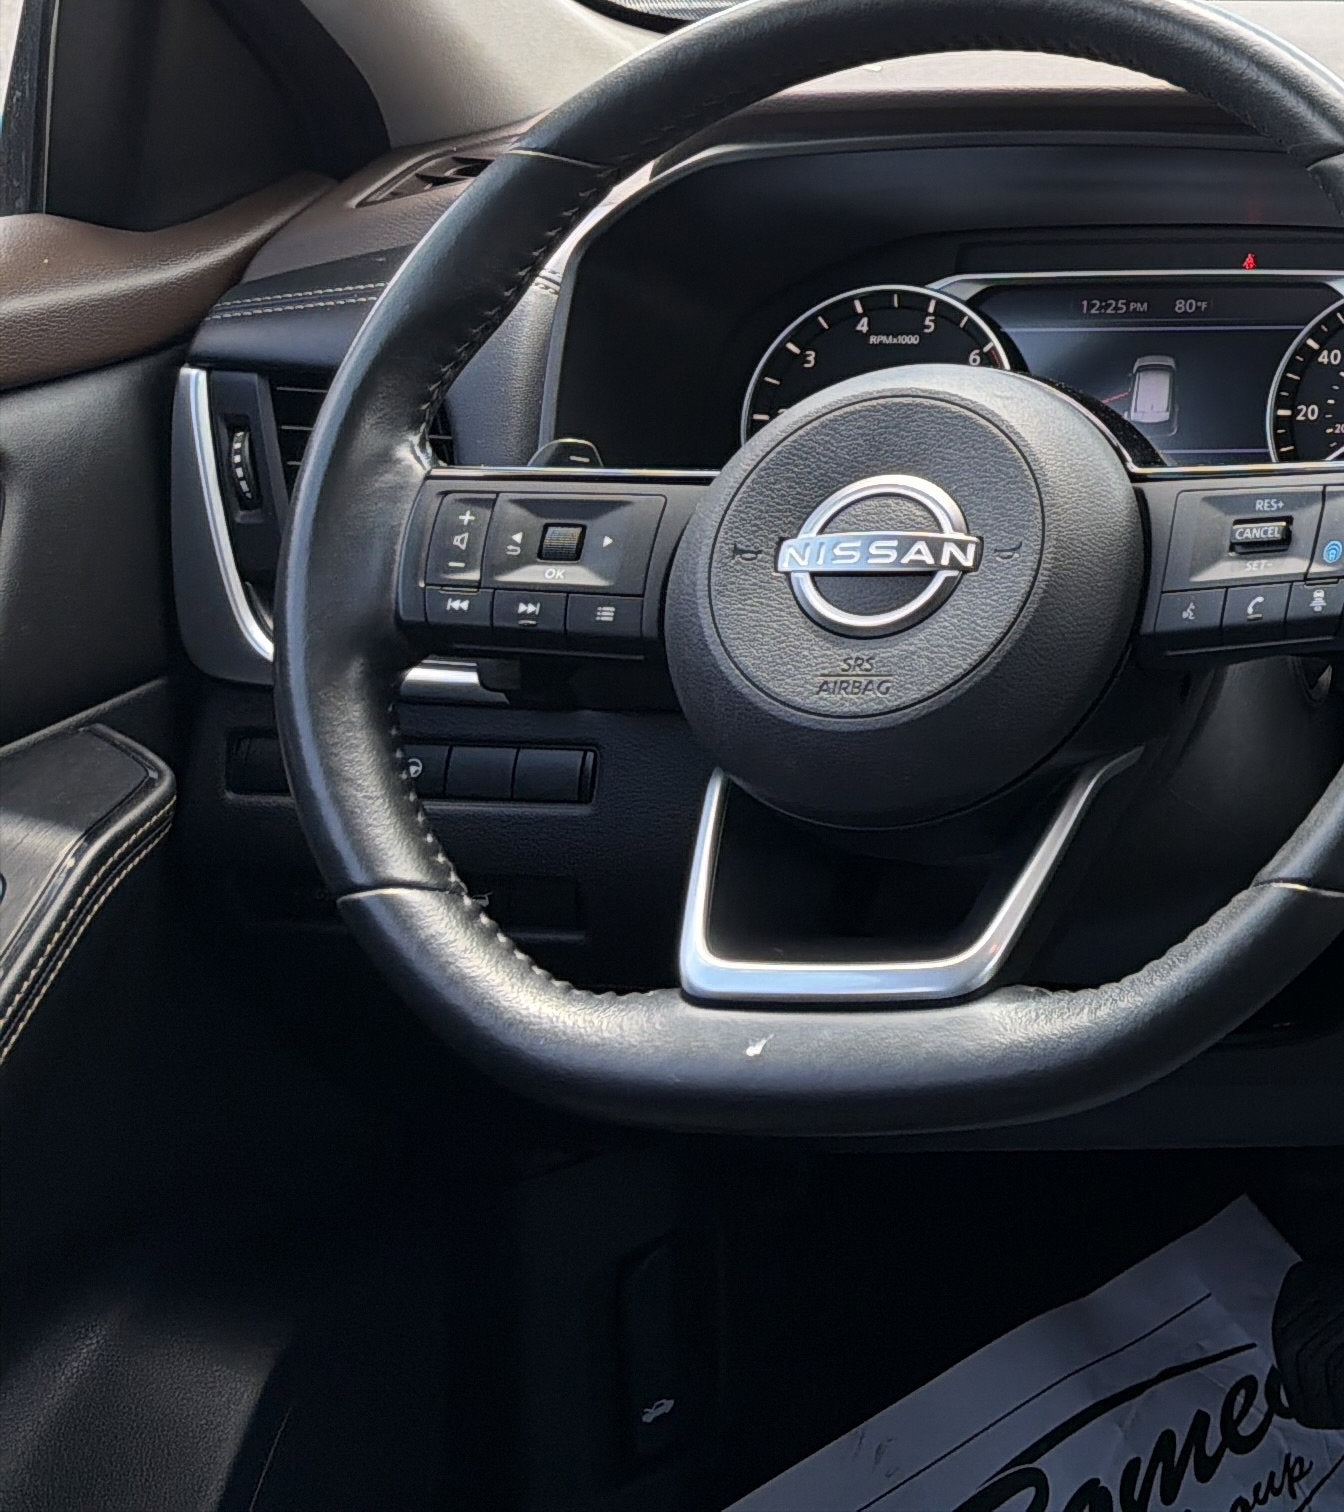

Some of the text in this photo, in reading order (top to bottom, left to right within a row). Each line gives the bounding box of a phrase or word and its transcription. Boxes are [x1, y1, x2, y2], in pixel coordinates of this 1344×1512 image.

[1081, 299, 1148, 314] 12:25 PM
[1174, 298, 1208, 314] 80°F
[855, 316, 869, 334] 4
[923, 316, 936, 333] 5
[802, 350, 816, 368] 3
[968, 350, 981, 367] 6
[1317, 349, 1342, 366] 40
[1296, 404, 1319, 421] 20
[1255, 498, 1285, 511] RES+
[1235, 526, 1282, 540] CANCEL
[782, 539, 977, 569] NISSAN
[544, 568, 566, 580] OK
[1245, 560, 1274, 572] SET-
[840, 656, 876, 673] SRS
[815, 679, 892, 697] AIRBAG
